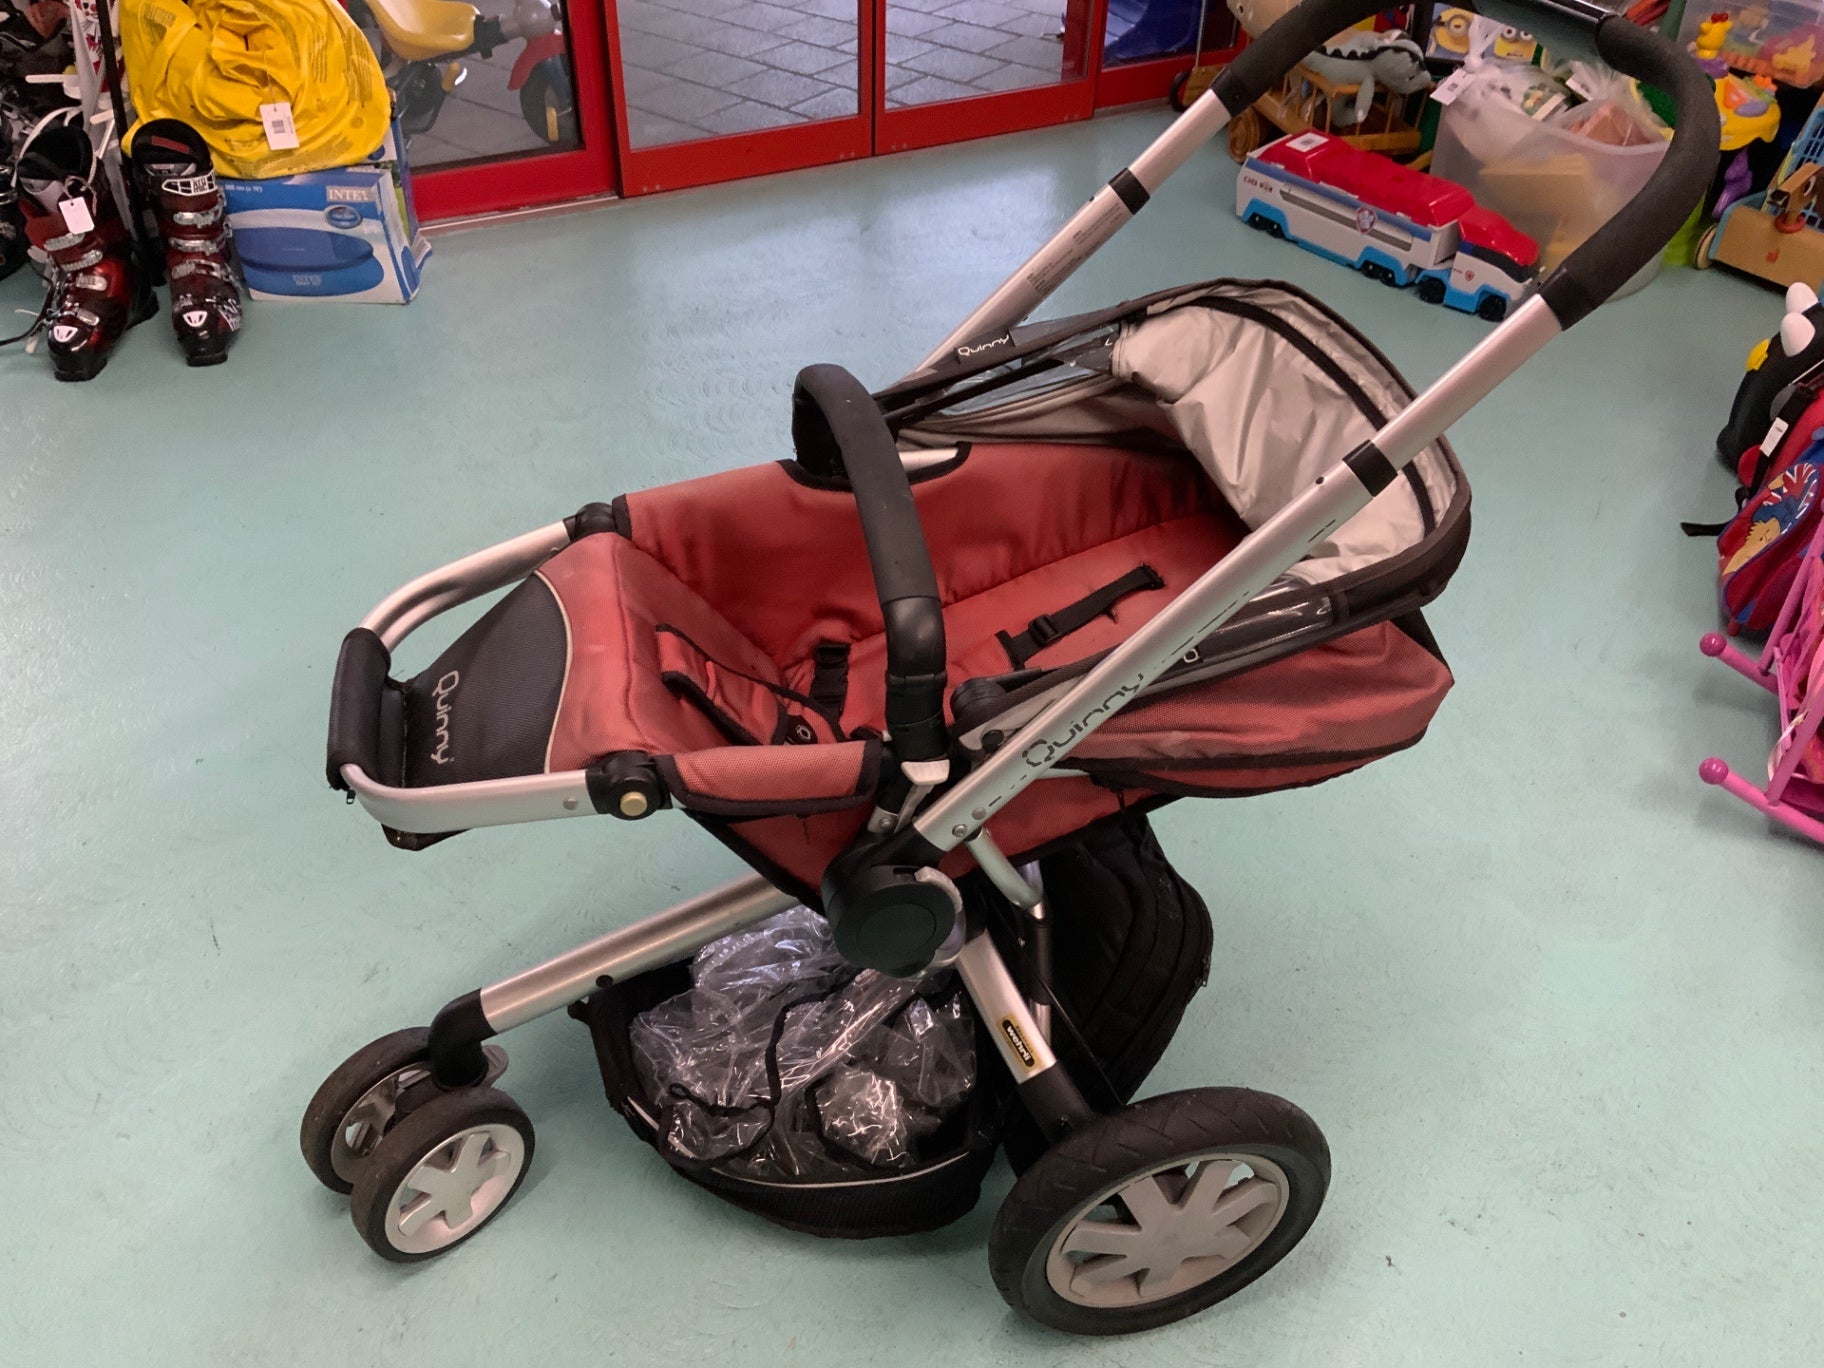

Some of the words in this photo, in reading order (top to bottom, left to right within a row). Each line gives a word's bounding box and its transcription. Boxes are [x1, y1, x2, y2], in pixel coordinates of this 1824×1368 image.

[328, 189, 368, 201] INTEX
[957, 335, 1010, 357] Quinny
[430, 670, 460, 765] Quinny
[1021, 672, 1144, 768] Quinny
[1006, 1026, 1031, 1062] wehrli
